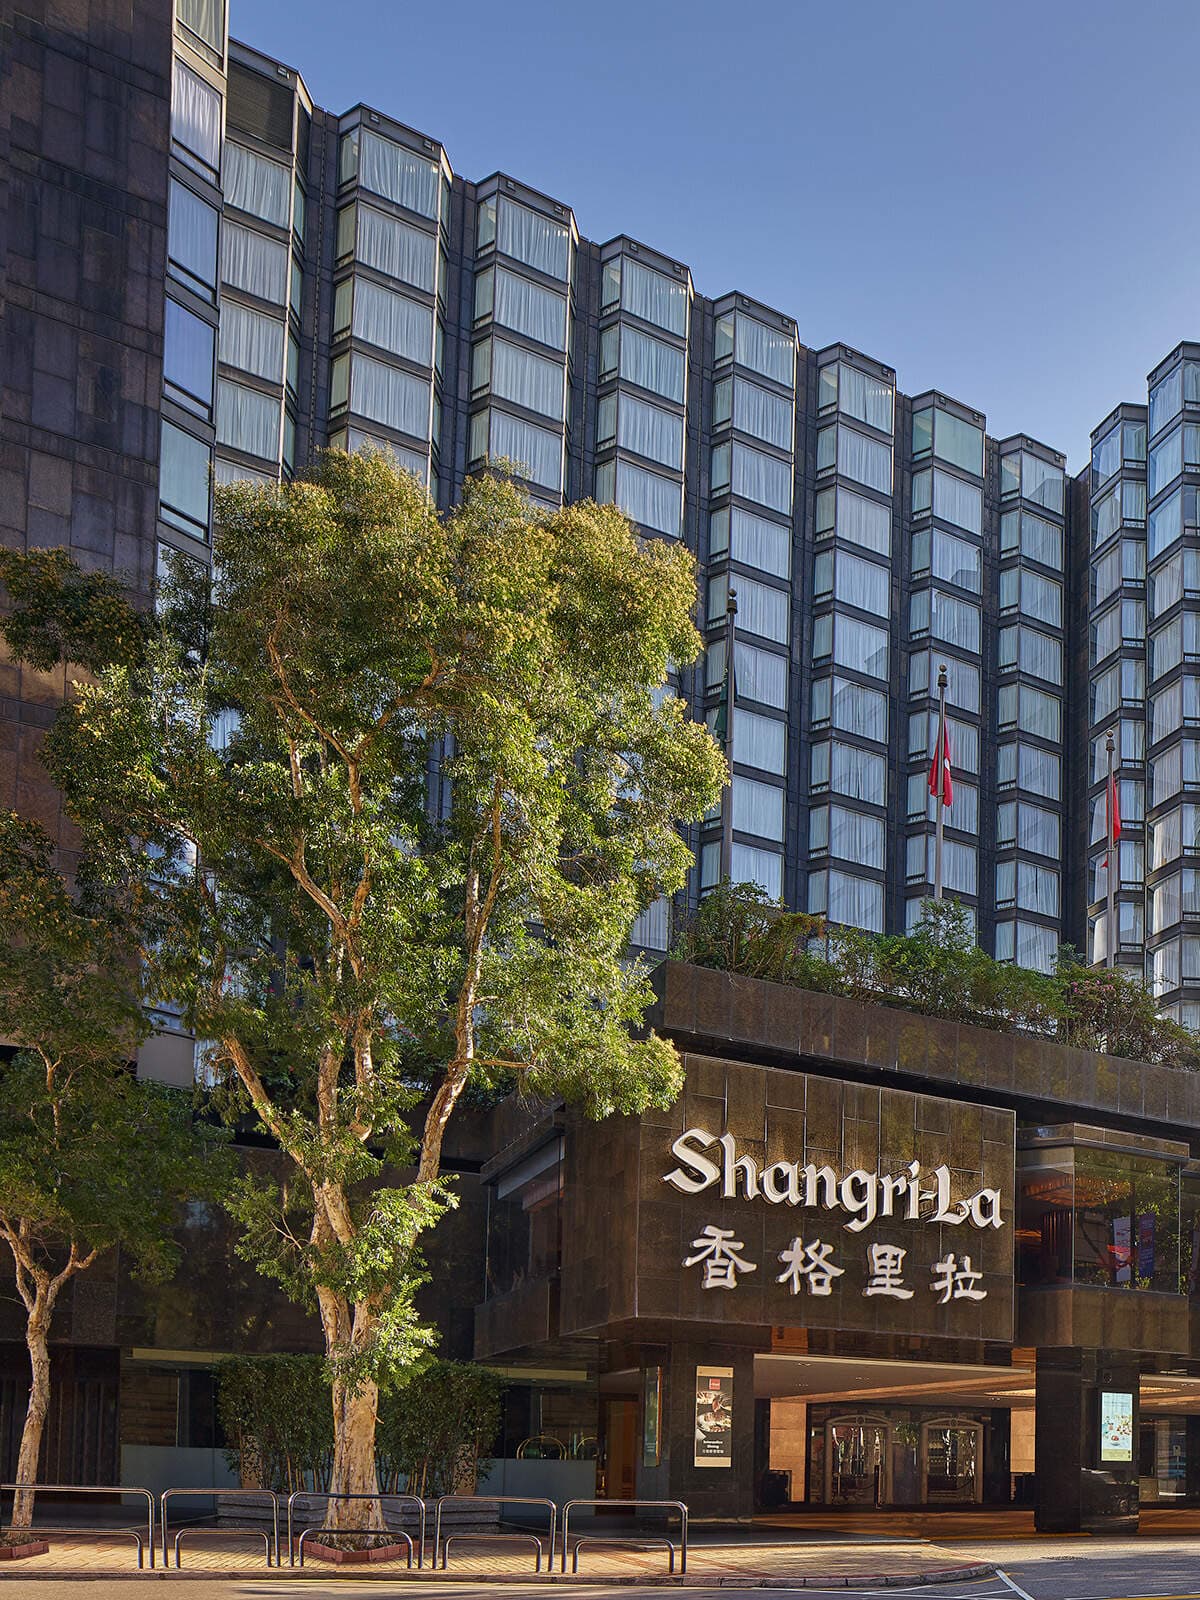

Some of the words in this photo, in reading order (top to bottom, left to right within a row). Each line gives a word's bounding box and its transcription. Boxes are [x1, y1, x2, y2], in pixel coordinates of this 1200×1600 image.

[662, 1128, 1006, 1233] Shangri-La
[682, 1224, 988, 1304] 香格里拉
